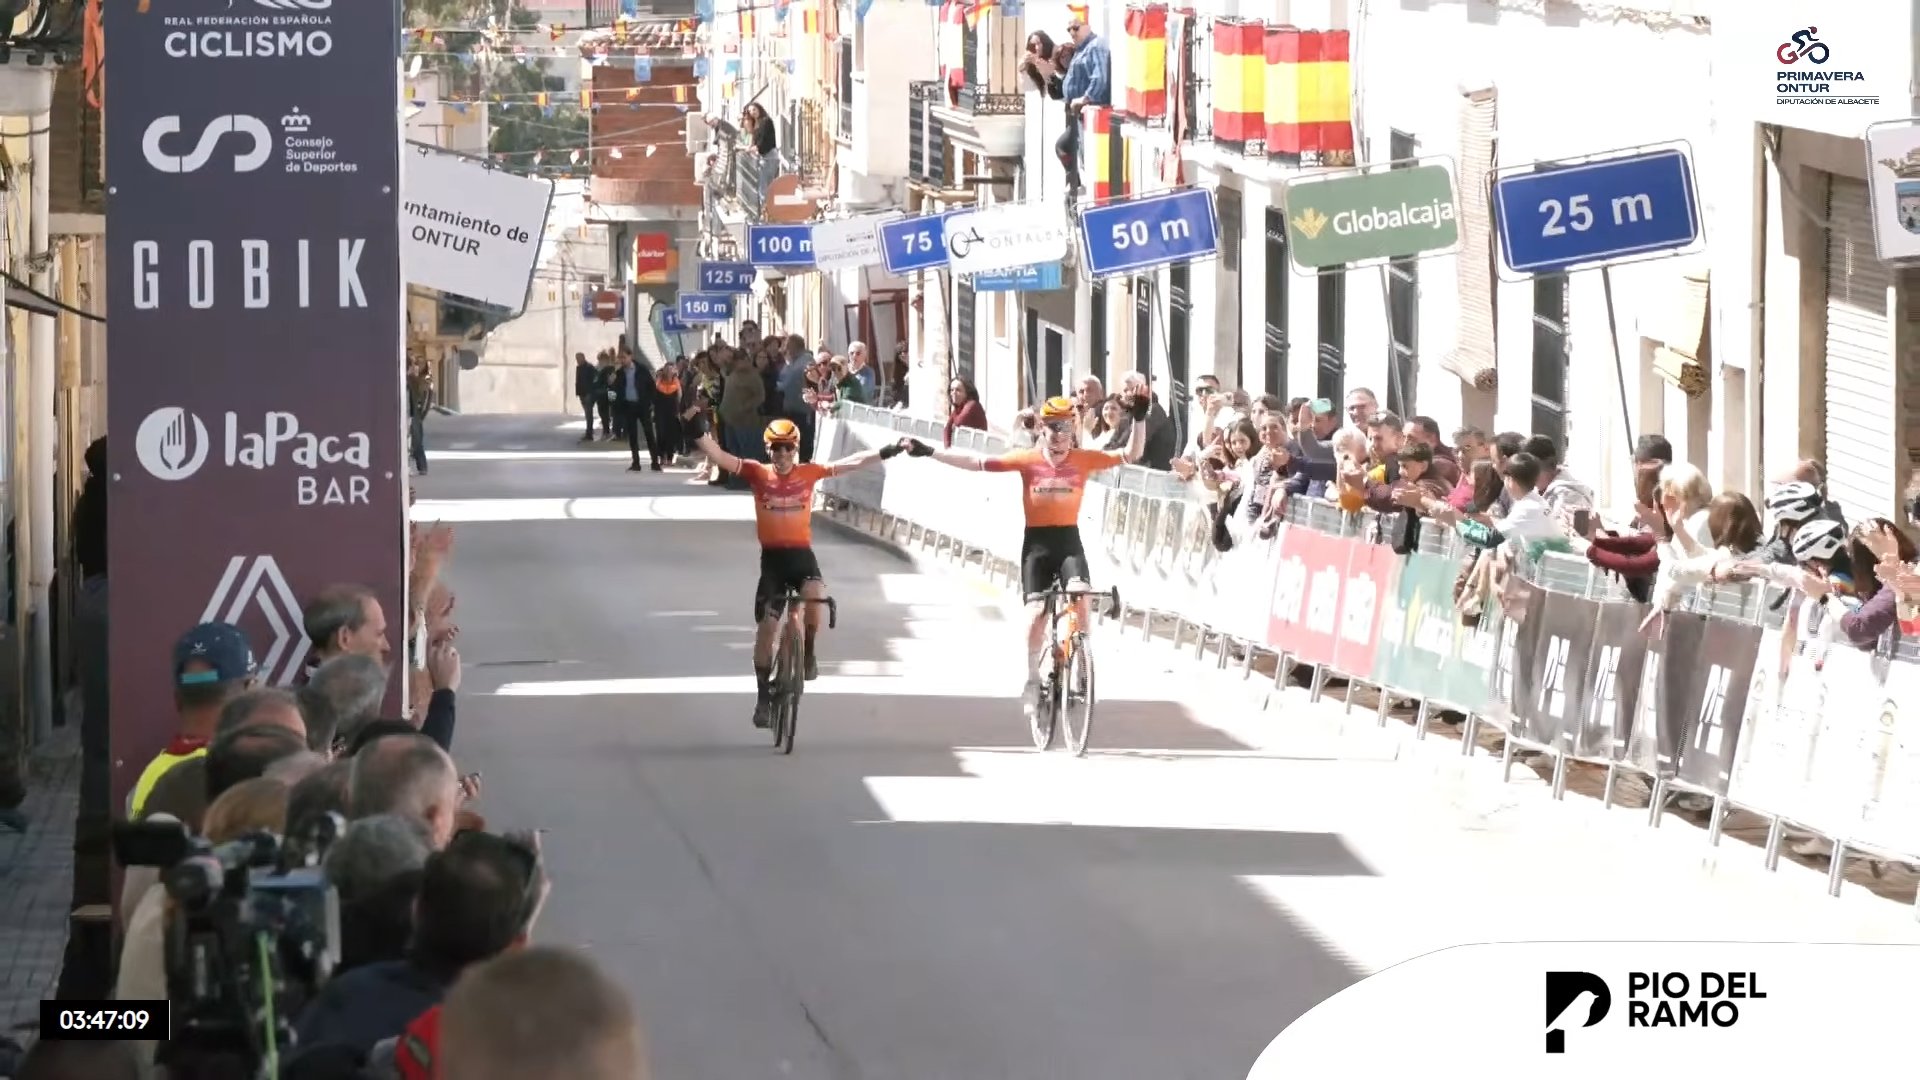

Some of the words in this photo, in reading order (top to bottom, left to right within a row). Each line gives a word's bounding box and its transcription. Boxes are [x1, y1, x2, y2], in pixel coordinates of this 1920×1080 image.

[164, 16, 193, 26] REAL
[196, 15, 269, 26] FEDERACIÓN
[272, 13, 332, 26] ESPAÑOLA
[164, 30, 333, 58] CICLISMO
[285, 136, 334, 152] Consejo
[285, 149, 337, 163] Superior
[285, 161, 301, 173] de
[303, 161, 359, 174] Deportes
[1332, 197, 1455, 236] Globalcaja
[1538, 193, 1594, 237] 25
[1611, 193, 1653, 225] m
[411, 224, 481, 257] ONTUR
[506, 225, 530, 244] de
[757, 235, 793, 254] 100
[902, 230, 933, 255] 75
[1112, 219, 1149, 250] 50
[1160, 217, 1190, 242] m
[132, 238, 369, 310] GOBIK
[705, 271, 735, 285] 125
[739, 273, 754, 285] m
[684, 301, 710, 314] 150
[713, 303, 727, 314] m
[224, 410, 371, 470] laPaca
[298, 475, 371, 506] BAR
